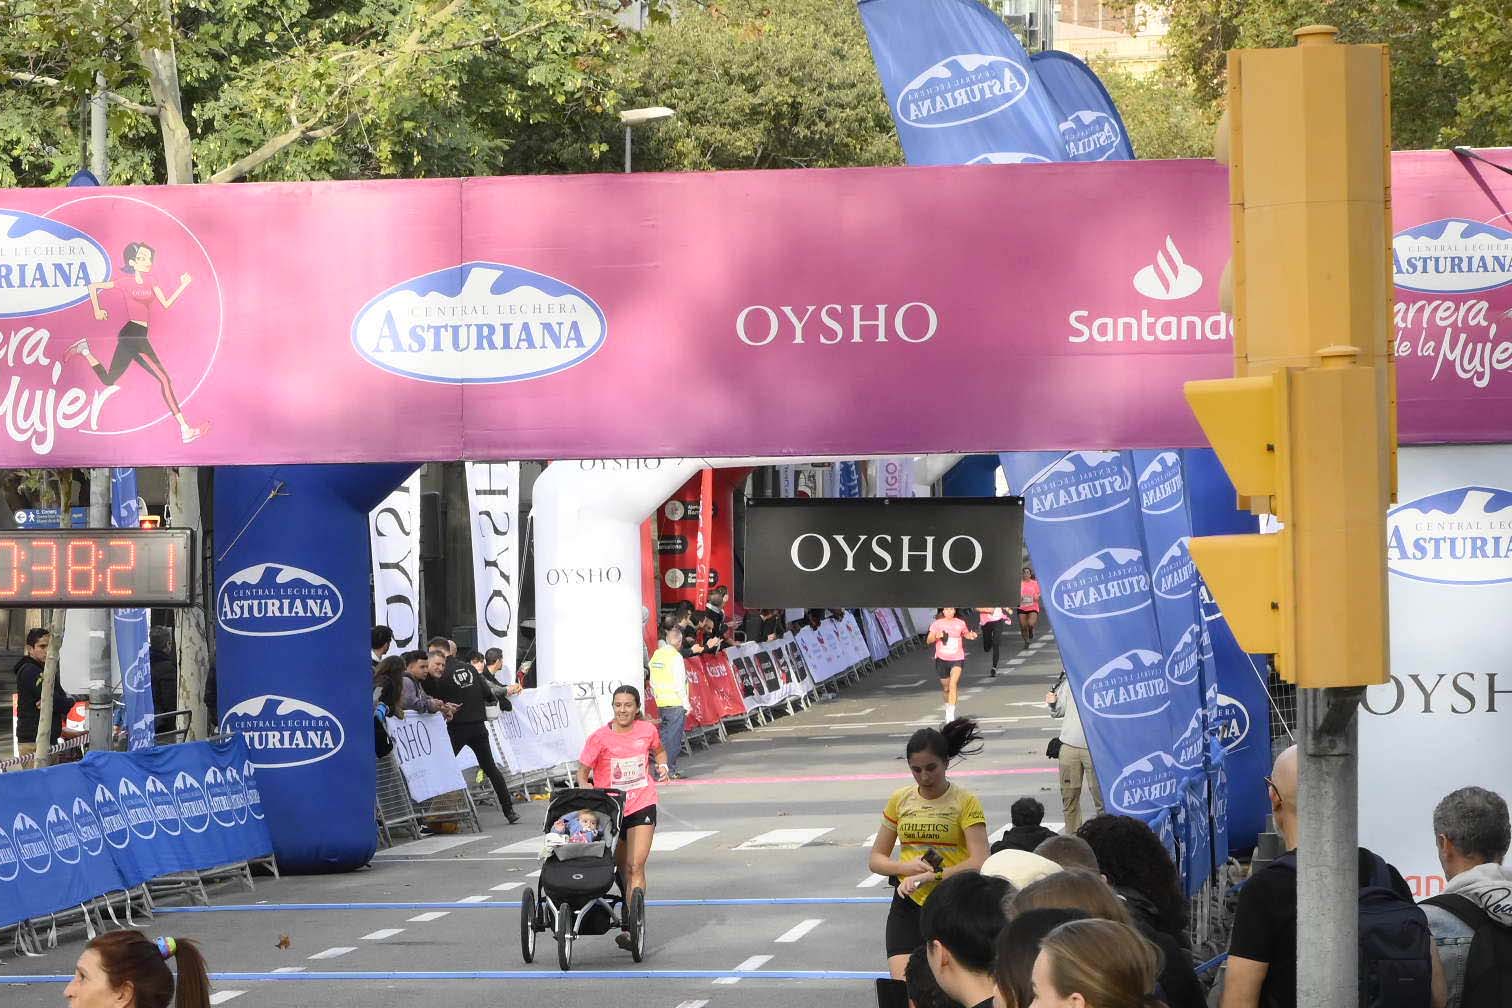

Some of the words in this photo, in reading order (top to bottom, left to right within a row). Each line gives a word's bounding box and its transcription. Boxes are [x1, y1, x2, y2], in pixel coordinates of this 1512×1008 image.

[14, 245, 87, 256] LECHERA
[408, 305, 488, 317] CENTRAL
[496, 303, 578, 315] LECHERA
[735, 301, 938, 346] OYSHO
[1393, 300, 1489, 328] arrera
[371, 309, 587, 353] ASTURIANA
[1068, 310, 1234, 344] Santand
[1417, 329, 1436, 356] la
[1430, 323, 1512, 388] Muje
[790, 533, 983, 574] OYSHO
[1387, 525, 1512, 561] ASTURI
[547, 566, 622, 586] OYSHO
[233, 588, 276, 597] CENTRAL
[280, 588, 329, 596] LECHERA
[221, 593, 333, 621] ASTURIANA
[236, 720, 277, 729] CENTRAL
[282, 720, 330, 728] LECHERA
[526, 699, 570, 736] OYSHO
[900, 823, 949, 832] ATHLETICS
